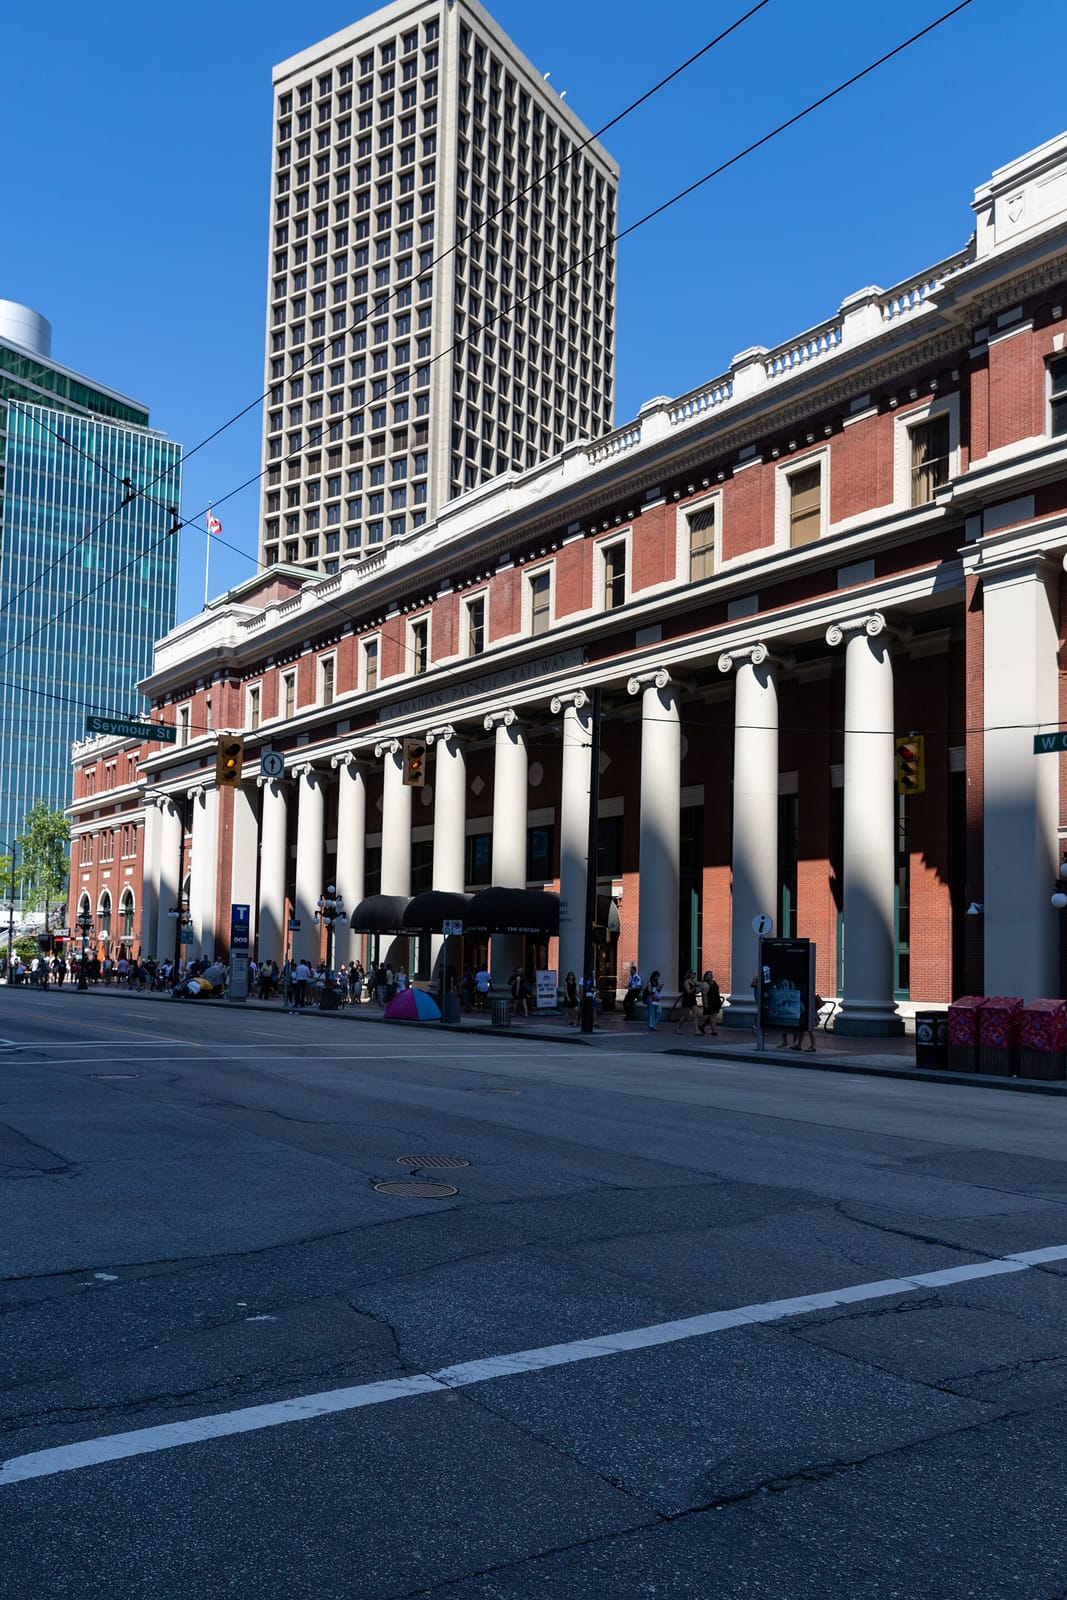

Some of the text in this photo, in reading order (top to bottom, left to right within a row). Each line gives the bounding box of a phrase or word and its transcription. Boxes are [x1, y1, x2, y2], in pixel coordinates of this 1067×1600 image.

[389, 654, 567, 717] CANADIAN PACIFIC RAILWAY
[92, 718, 171, 740] Seymour St
[1041, 735, 1056, 750] W
[237, 907, 247, 920] T
